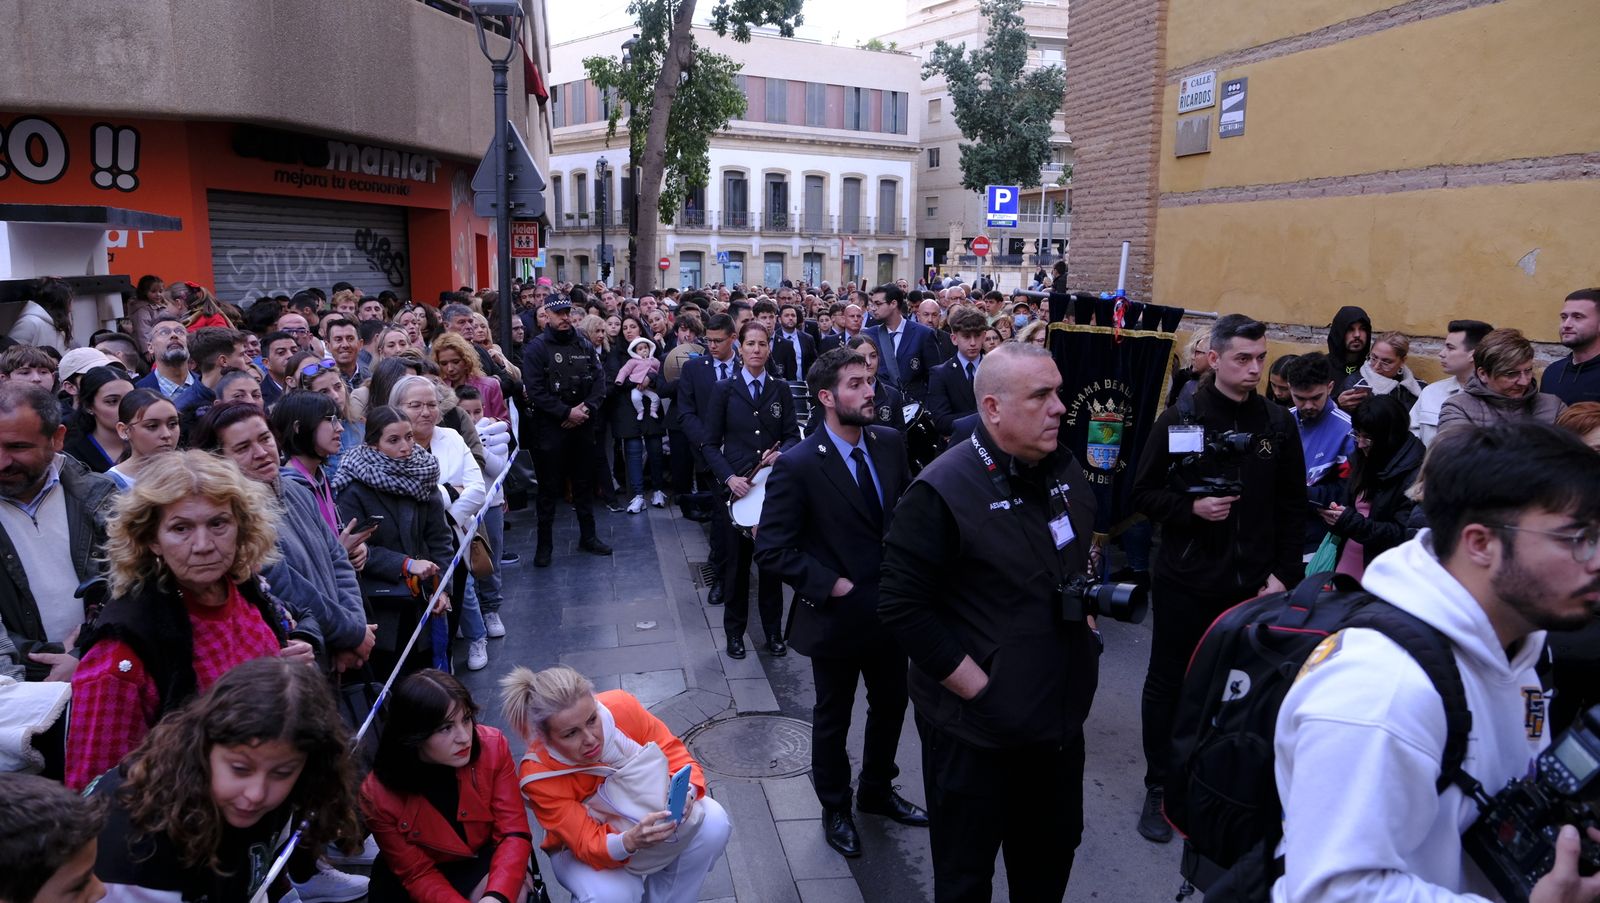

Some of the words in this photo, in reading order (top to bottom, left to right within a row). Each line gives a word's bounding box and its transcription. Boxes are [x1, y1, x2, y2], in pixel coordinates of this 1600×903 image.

[1191, 75, 1212, 88] CALLE
[1179, 89, 1211, 109] RICARDOS
[0, 114, 70, 185] O
[274, 168, 328, 188] mejora
[332, 174, 346, 190] tu
[994, 188, 1012, 211] P
[511, 223, 537, 234] Helen
[1066, 381, 1101, 427] ALHAMA
[1104, 379, 1119, 390] DE
